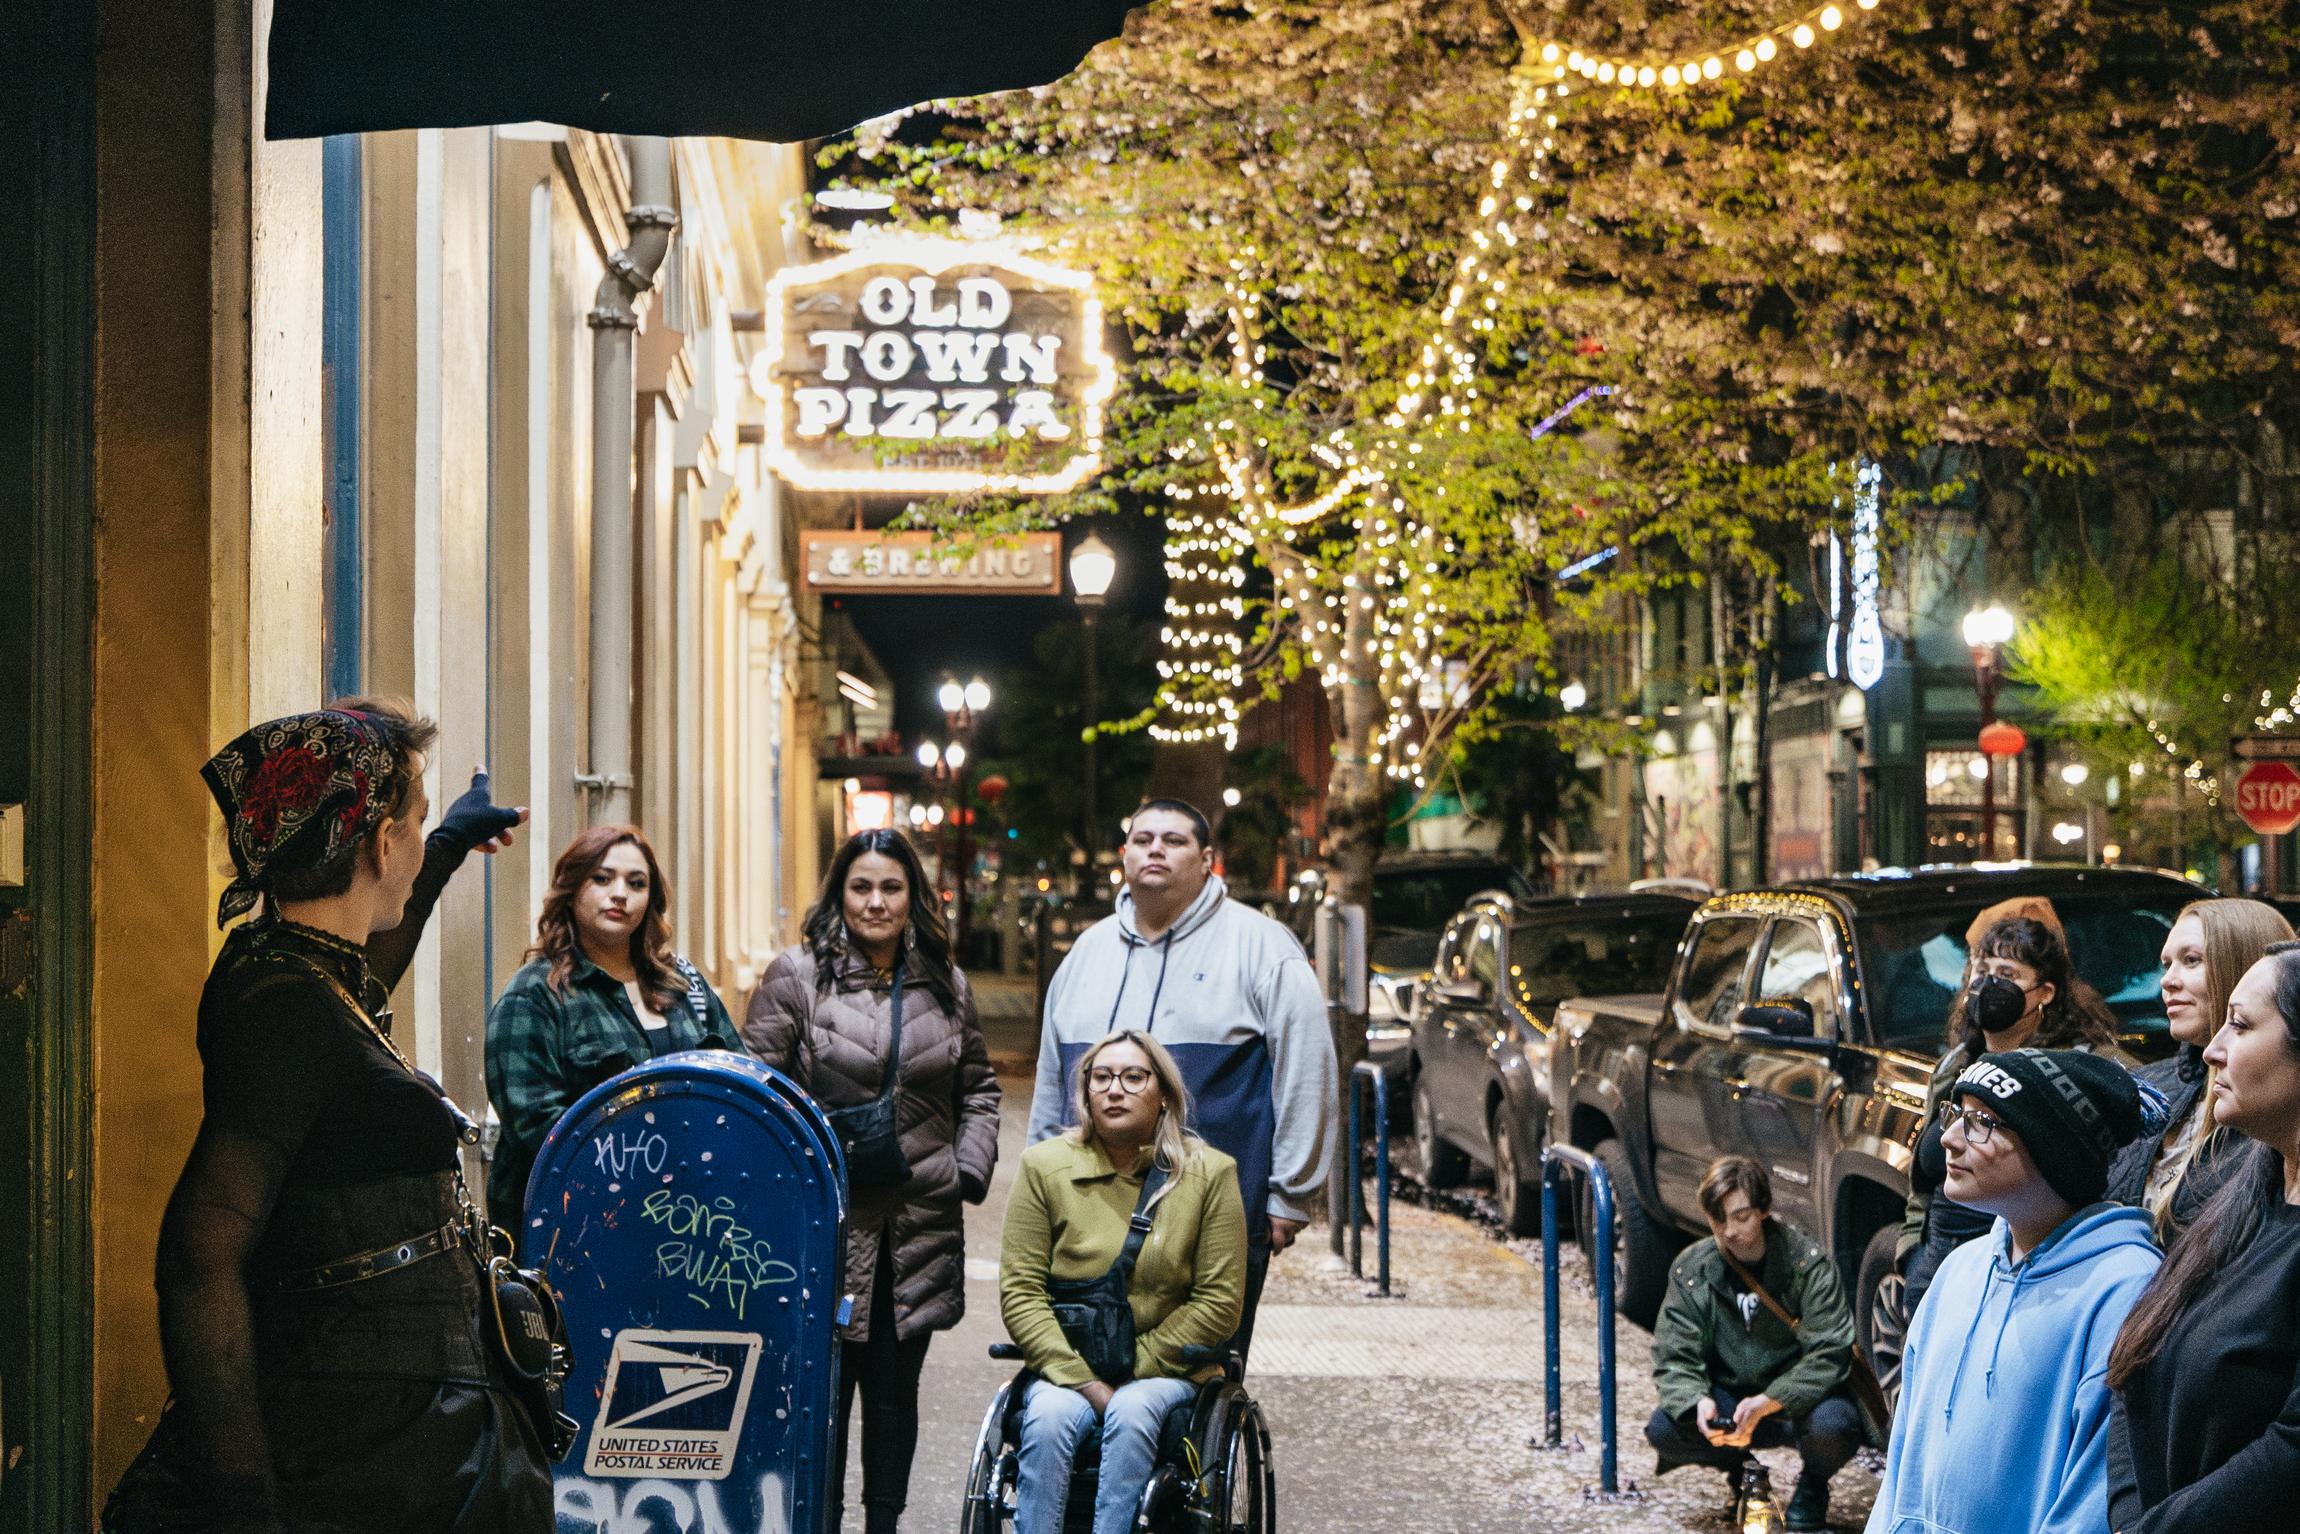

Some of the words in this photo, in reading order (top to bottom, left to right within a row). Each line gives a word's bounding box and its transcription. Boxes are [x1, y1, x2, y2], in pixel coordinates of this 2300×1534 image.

[860, 276, 1012, 328] OLD
[809, 330, 1062, 383] TOWN
[794, 387, 1071, 440] PIZZA
[828, 549, 851, 576] &
[863, 548, 1031, 576] BREWING
[2240, 782, 2300, 811] STOP
[598, 1438, 660, 1452] UNITED
[662, 1440, 718, 1454] STATES
[594, 1455, 653, 1469] POSTAL
[657, 1456, 723, 1471] SERVICE
